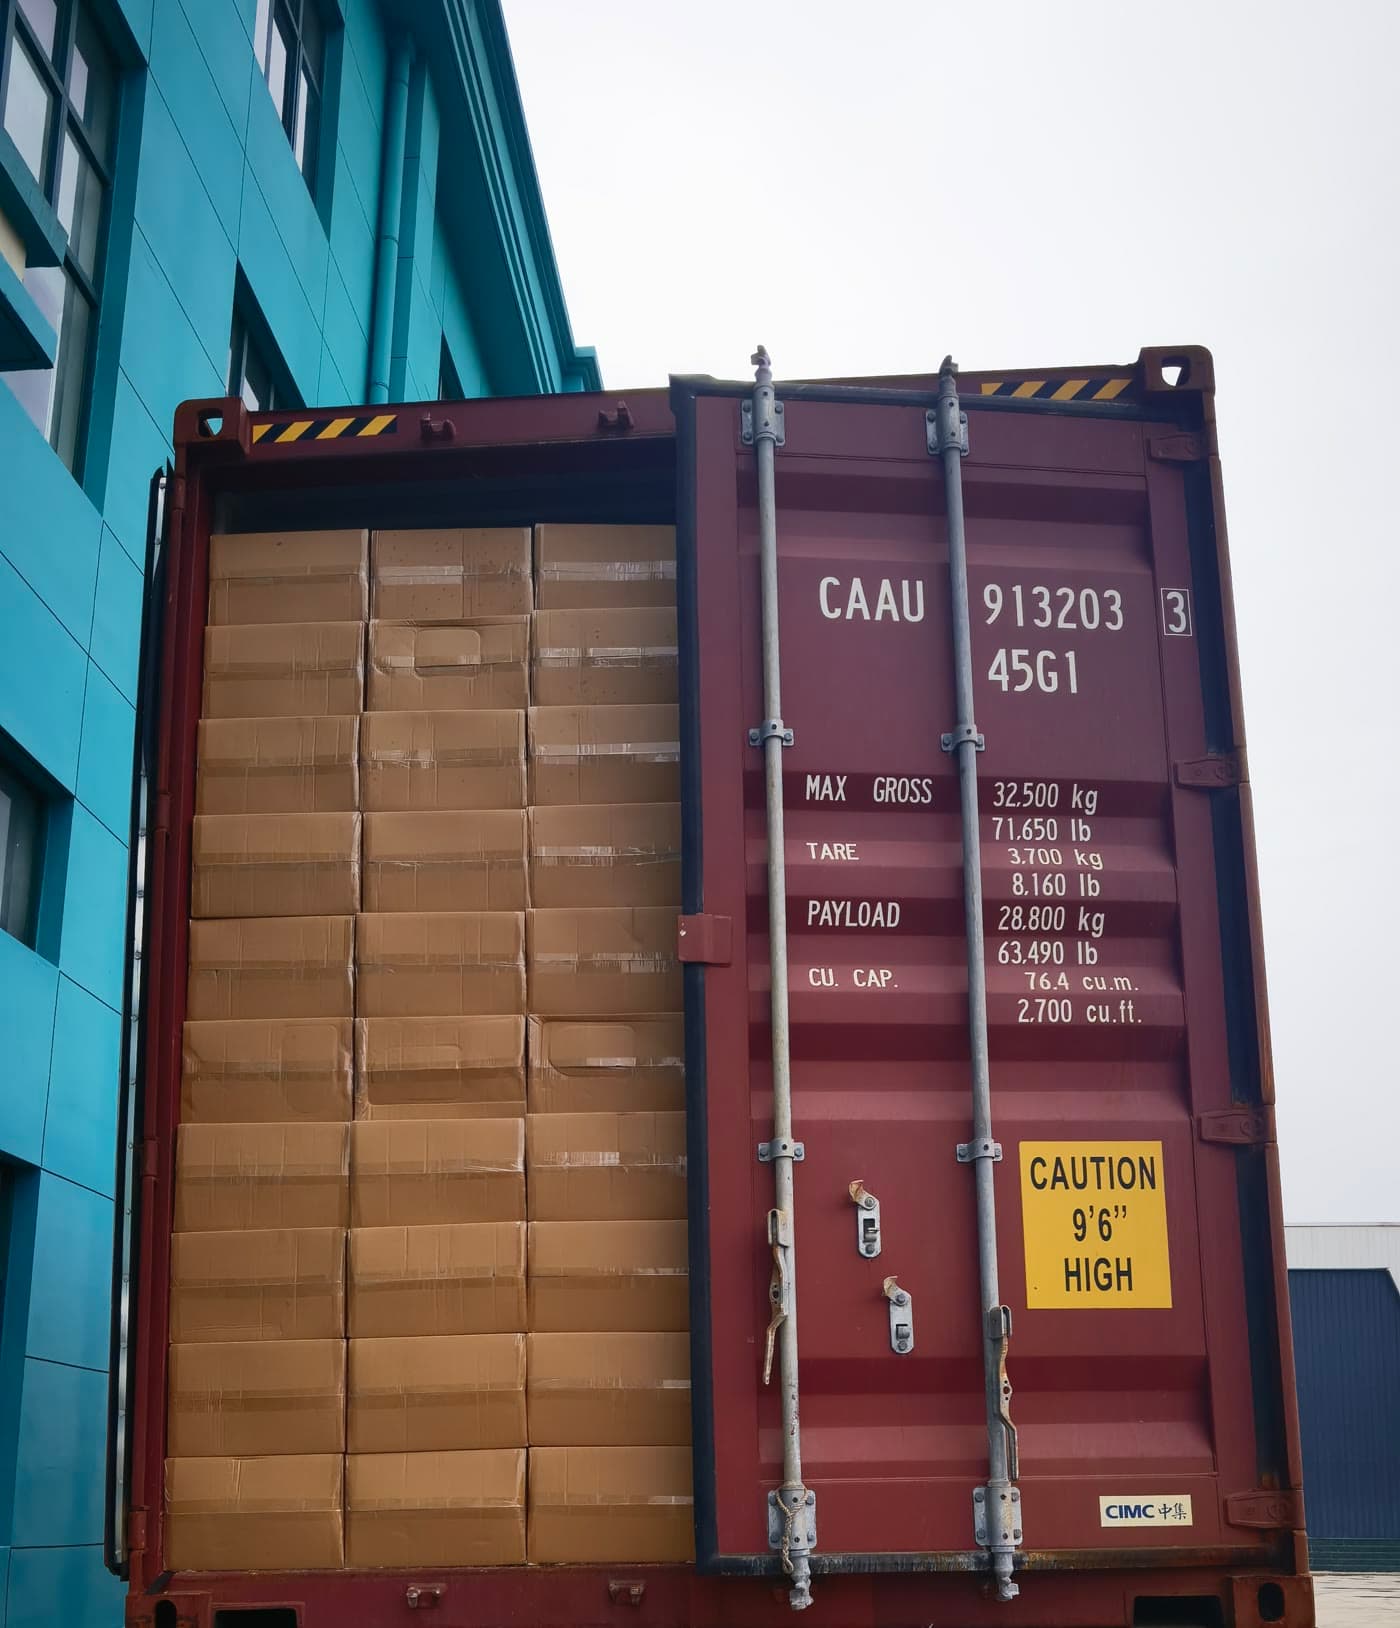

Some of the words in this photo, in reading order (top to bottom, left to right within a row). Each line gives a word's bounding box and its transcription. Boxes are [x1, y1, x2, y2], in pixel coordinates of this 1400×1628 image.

[819, 577, 925, 623] CAAU
[984, 584, 1124, 631] 913203
[1168, 592, 1188, 632] 3
[987, 649, 1078, 694] 45G1
[806, 775, 847, 801] MAX
[873, 777, 932, 803] GROSS
[1072, 784, 1098, 815] kg
[1071, 819, 1091, 841] lb
[806, 843, 859, 860] TARE
[1074, 849, 1103, 870] kg
[1080, 873, 1100, 896] lb
[807, 901, 900, 928] PAYLOAD
[1078, 906, 1105, 937] kg
[1077, 941, 1098, 965] lb
[809, 968, 839, 987] CU.
[853, 969, 899, 988] CAP.
[1024, 972, 1069, 990] 76.4
[1083, 976, 1139, 991] cu.m.
[1087, 1000, 1142, 1023] cu.ft.
[1030, 1156, 1156, 1190] CAUTION
[1064, 1257, 1133, 1292] HIGH
[1105, 1504, 1155, 1519] CIMC
[1158, 1503, 1187, 1520] 中集
